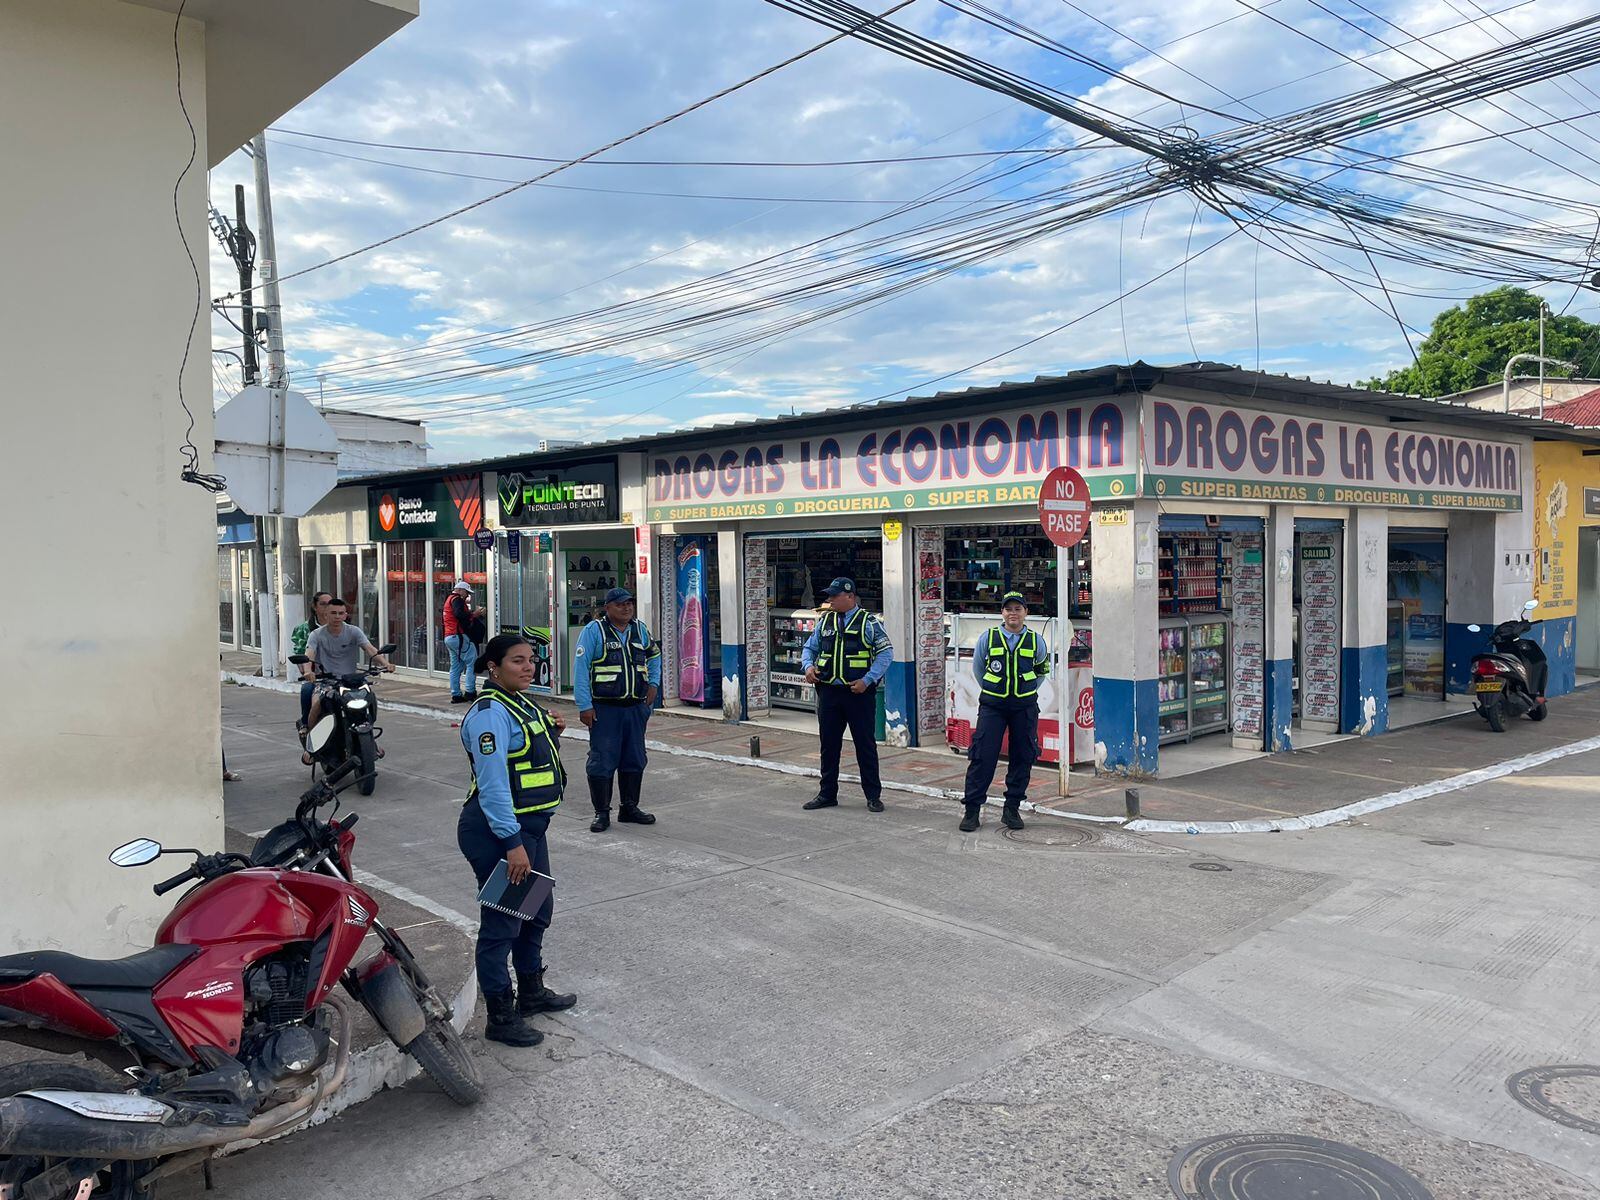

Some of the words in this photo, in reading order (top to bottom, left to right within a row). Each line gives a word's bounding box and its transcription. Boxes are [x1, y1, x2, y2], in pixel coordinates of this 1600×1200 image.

[654, 443, 785, 501] DROGAS
[800, 438, 842, 490] LA
[856, 403, 1124, 487] ECONOMIA
[1154, 401, 1325, 477] DROGAS
[1339, 426, 1374, 480] LA
[1385, 431, 1516, 490] ECONOMIA
[1056, 480, 1074, 499] NO
[1181, 480, 1237, 496] SUPER
[1242, 484, 1307, 500] BARATAS
[1334, 488, 1410, 505] DROGUERIA
[1431, 495, 1464, 506] SUPER
[1467, 497, 1506, 508] BARATAS
[398, 497, 422, 510] Banco
[581, 500, 605, 508] PUNTA
[670, 507, 706, 520] SUPER
[710, 503, 766, 517] BARATAS
[794, 496, 891, 513] DROGUERIA
[928, 489, 989, 506] SUPER
[399, 510, 437, 524] Contactar
[1048, 513, 1082, 532] PASE
[1303, 549, 1329, 558] SALIDA
[344, 918, 367, 927] HONDA
[202, 985, 233, 998] HONDA
